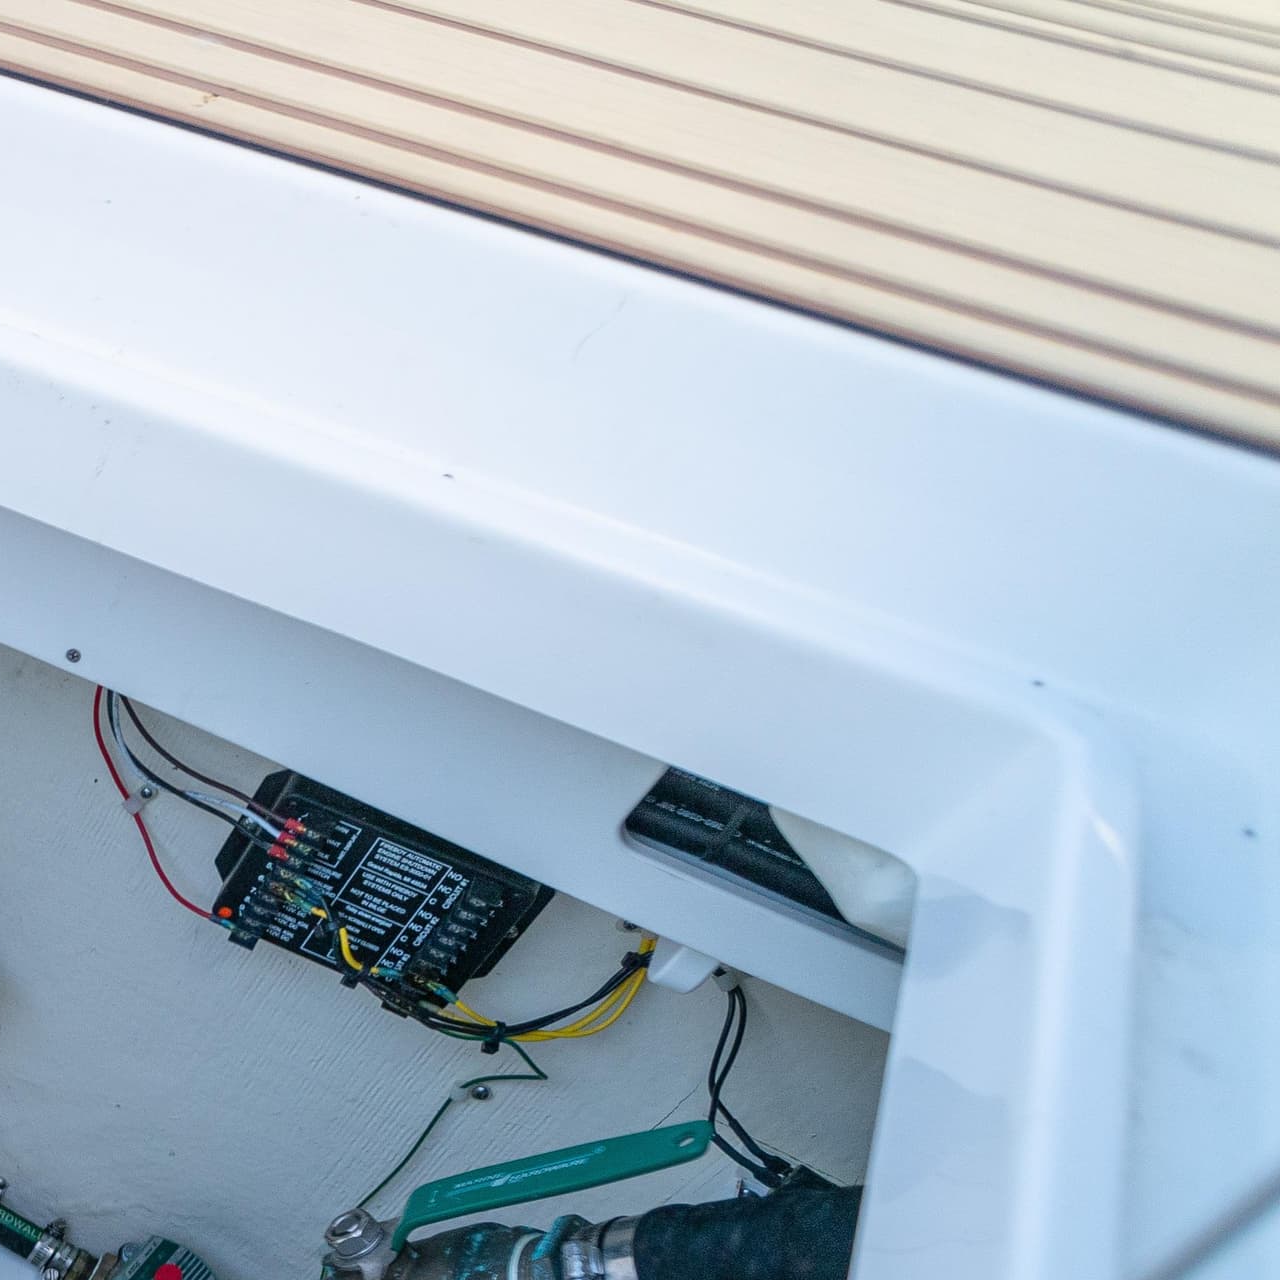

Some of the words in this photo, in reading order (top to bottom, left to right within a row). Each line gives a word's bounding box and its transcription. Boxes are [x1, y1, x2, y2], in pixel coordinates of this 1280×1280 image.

[447, 870, 463, 883] NO
[437, 883, 452, 896] NC
[417, 909, 432, 921] NO
[407, 921, 422, 934] NC
